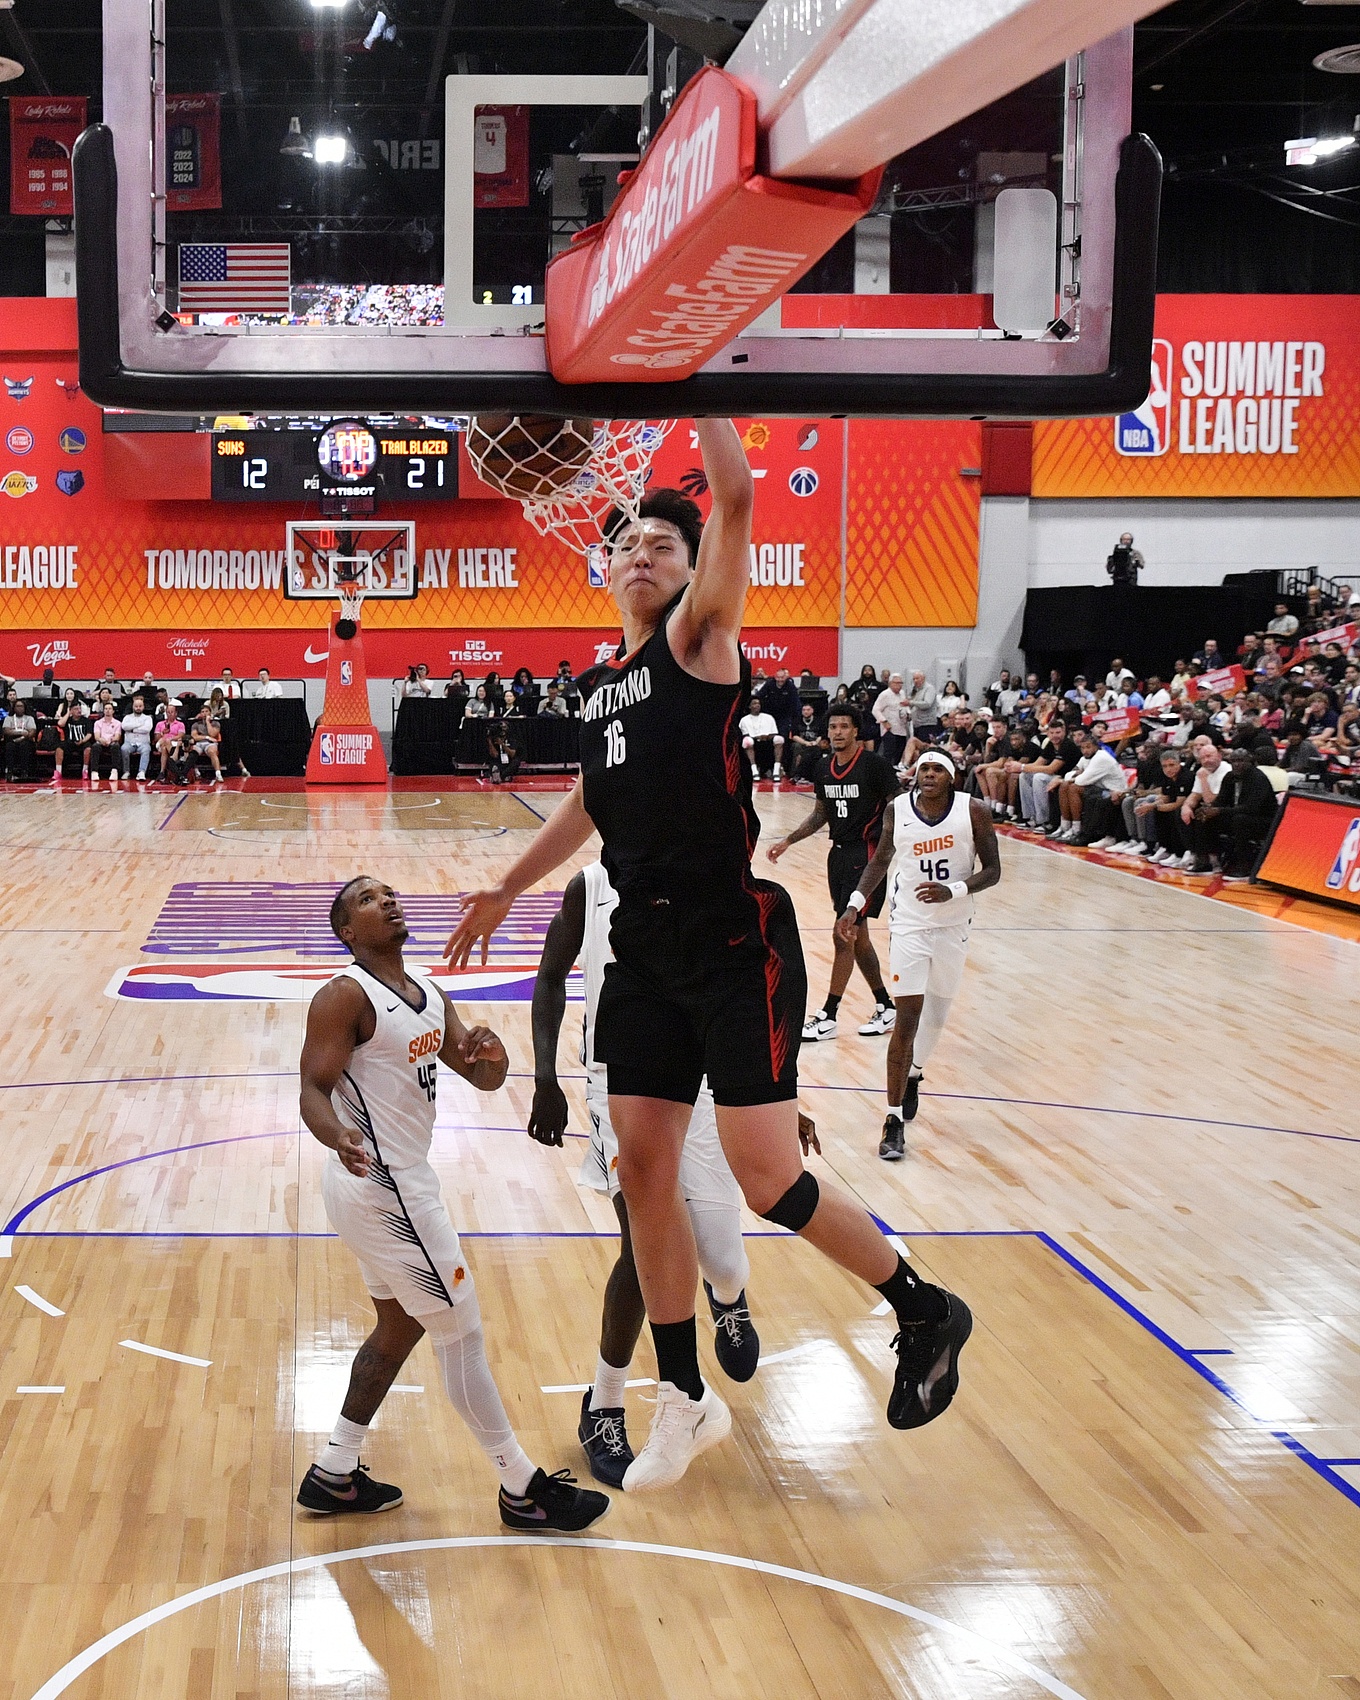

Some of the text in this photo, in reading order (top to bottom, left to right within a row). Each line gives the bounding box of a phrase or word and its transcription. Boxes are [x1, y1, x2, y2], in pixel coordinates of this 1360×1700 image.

[24, 104, 72, 118] Lady Rebels
[486, 132, 496, 146] 4
[174, 151, 192, 160] 2022
[173, 162, 194, 171] 2023
[173, 174, 194, 183] 2024
[511, 285, 532, 305] 21
[1181, 341, 1326, 397] SUMMER
[1179, 398, 1300, 454] LEAGUE
[380, 440, 448, 455] TRAIL BLAZER
[1123, 428, 1150, 448] NBA
[217, 441, 245, 455] SUNS
[242, 458, 268, 489] 12
[407, 458, 444, 489] 21
[336, 486, 376, 496] TISSOT
[393, 549, 451, 589] PAY
[458, 548, 519, 588] HERE
[27, 642, 76, 668] Vegas
[449, 650, 503, 662] TISSOT
[740, 642, 788, 662] finity
[583, 666, 652, 723] ORTLAND
[336, 734, 373, 750] SUMMER
[604, 719, 627, 768] 16
[335, 749, 367, 765] LEAGUE
[824, 783, 860, 799] PORTLAND
[835, 799, 848, 818] 26
[919, 858, 950, 881] 46
[416, 1062, 437, 1102] 45
